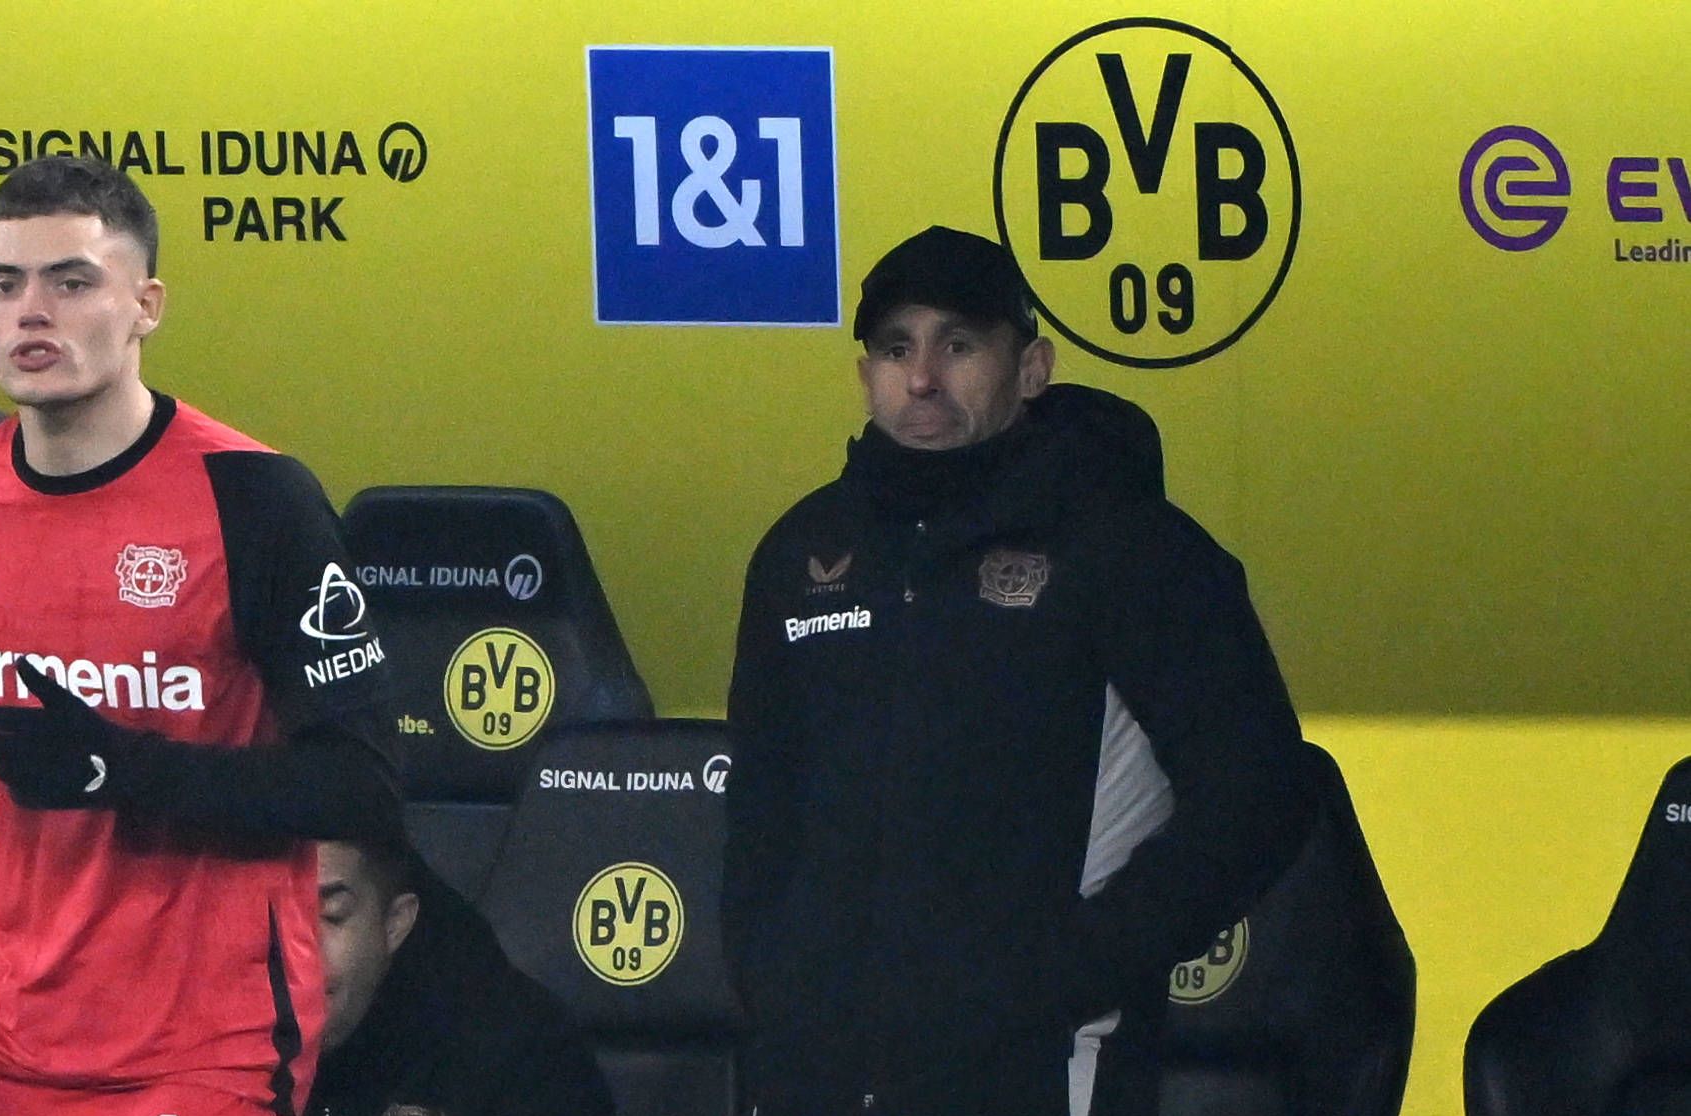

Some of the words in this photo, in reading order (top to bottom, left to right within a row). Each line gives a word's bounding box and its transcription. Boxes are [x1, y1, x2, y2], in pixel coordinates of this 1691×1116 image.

[201, 131, 366, 176] IDUNA
[1035, 53, 1269, 261] BVB
[614, 115, 804, 247] 1&1
[204, 197, 346, 242] PARK
[1110, 262, 1195, 334] 09
[430, 567, 501, 587] IDUNA
[785, 605, 871, 642] Barmenia
[461, 642, 540, 713] BVB
[483, 712, 511, 735] 09
[539, 769, 620, 790] SIGNAL
[626, 772, 695, 791] IDUNA
[589, 877, 671, 946] BVB
[612, 946, 642, 971] 09
[1176, 966, 1205, 990] 09
